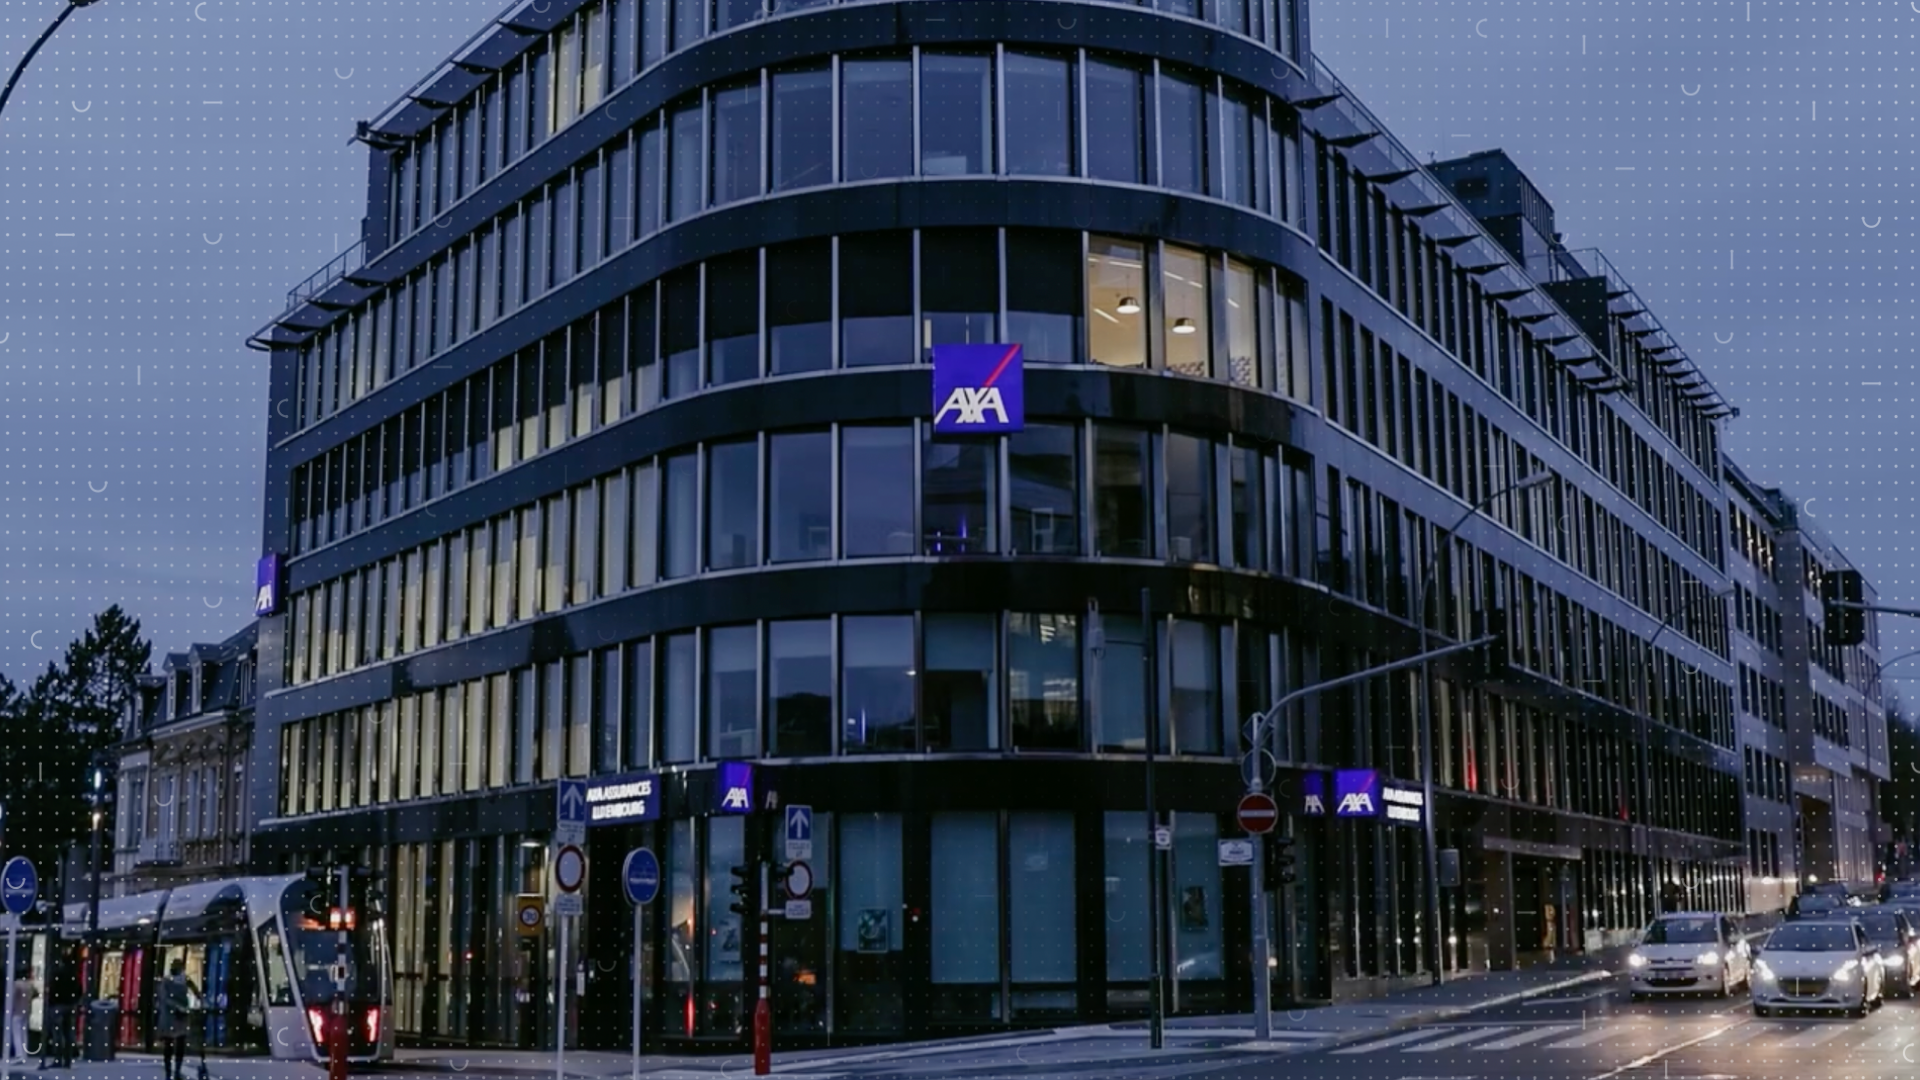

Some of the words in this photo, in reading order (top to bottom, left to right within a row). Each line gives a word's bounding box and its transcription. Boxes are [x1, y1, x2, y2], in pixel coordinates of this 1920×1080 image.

[934, 387, 1009, 425] AXA
[721, 787, 749, 808] AXA
[1337, 792, 1374, 813] AXA
